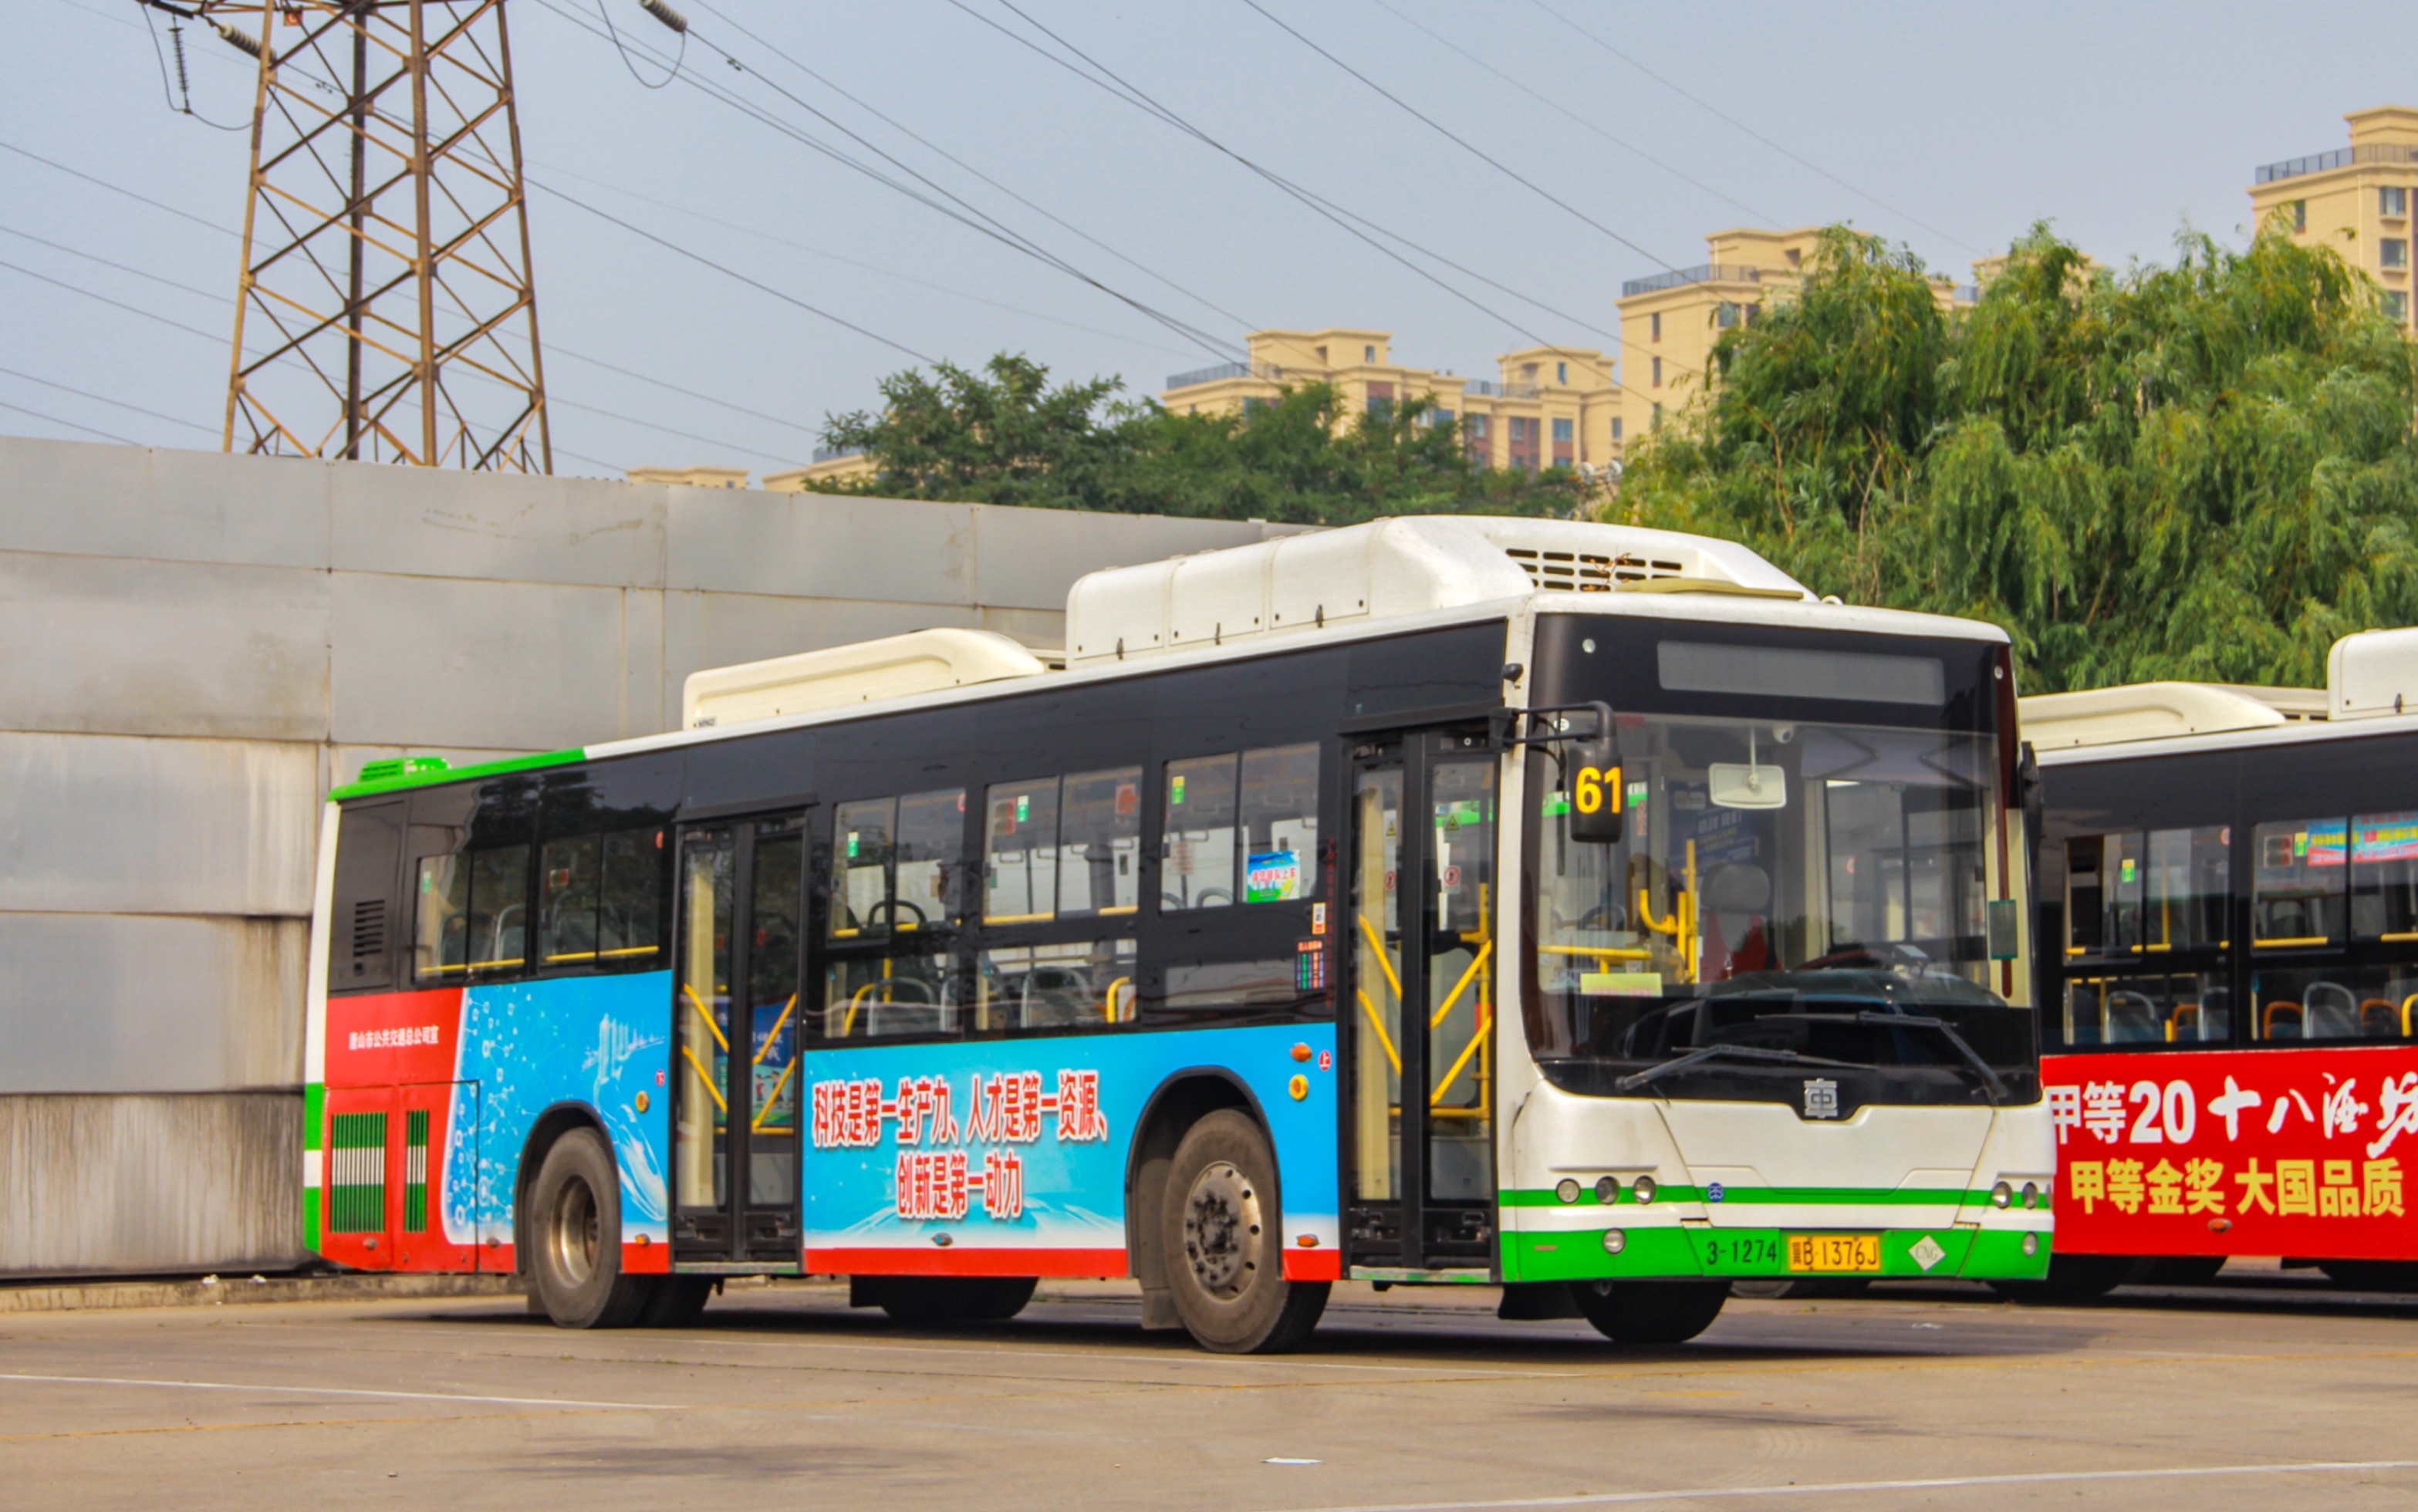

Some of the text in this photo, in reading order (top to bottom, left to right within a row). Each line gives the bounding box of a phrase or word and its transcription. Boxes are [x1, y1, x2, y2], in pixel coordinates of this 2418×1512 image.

[1575, 765, 1623, 815] 61
[348, 1025, 440, 1051] 唐山市公共交通总公司宣
[897, 1149, 1023, 1218] 创新是第一动力
[2070, 1158, 2405, 1217] 甲等金奖 大国品质
[1707, 1240, 1777, 1265] 3-1274
[1915, 1244, 1939, 1261] CNG
